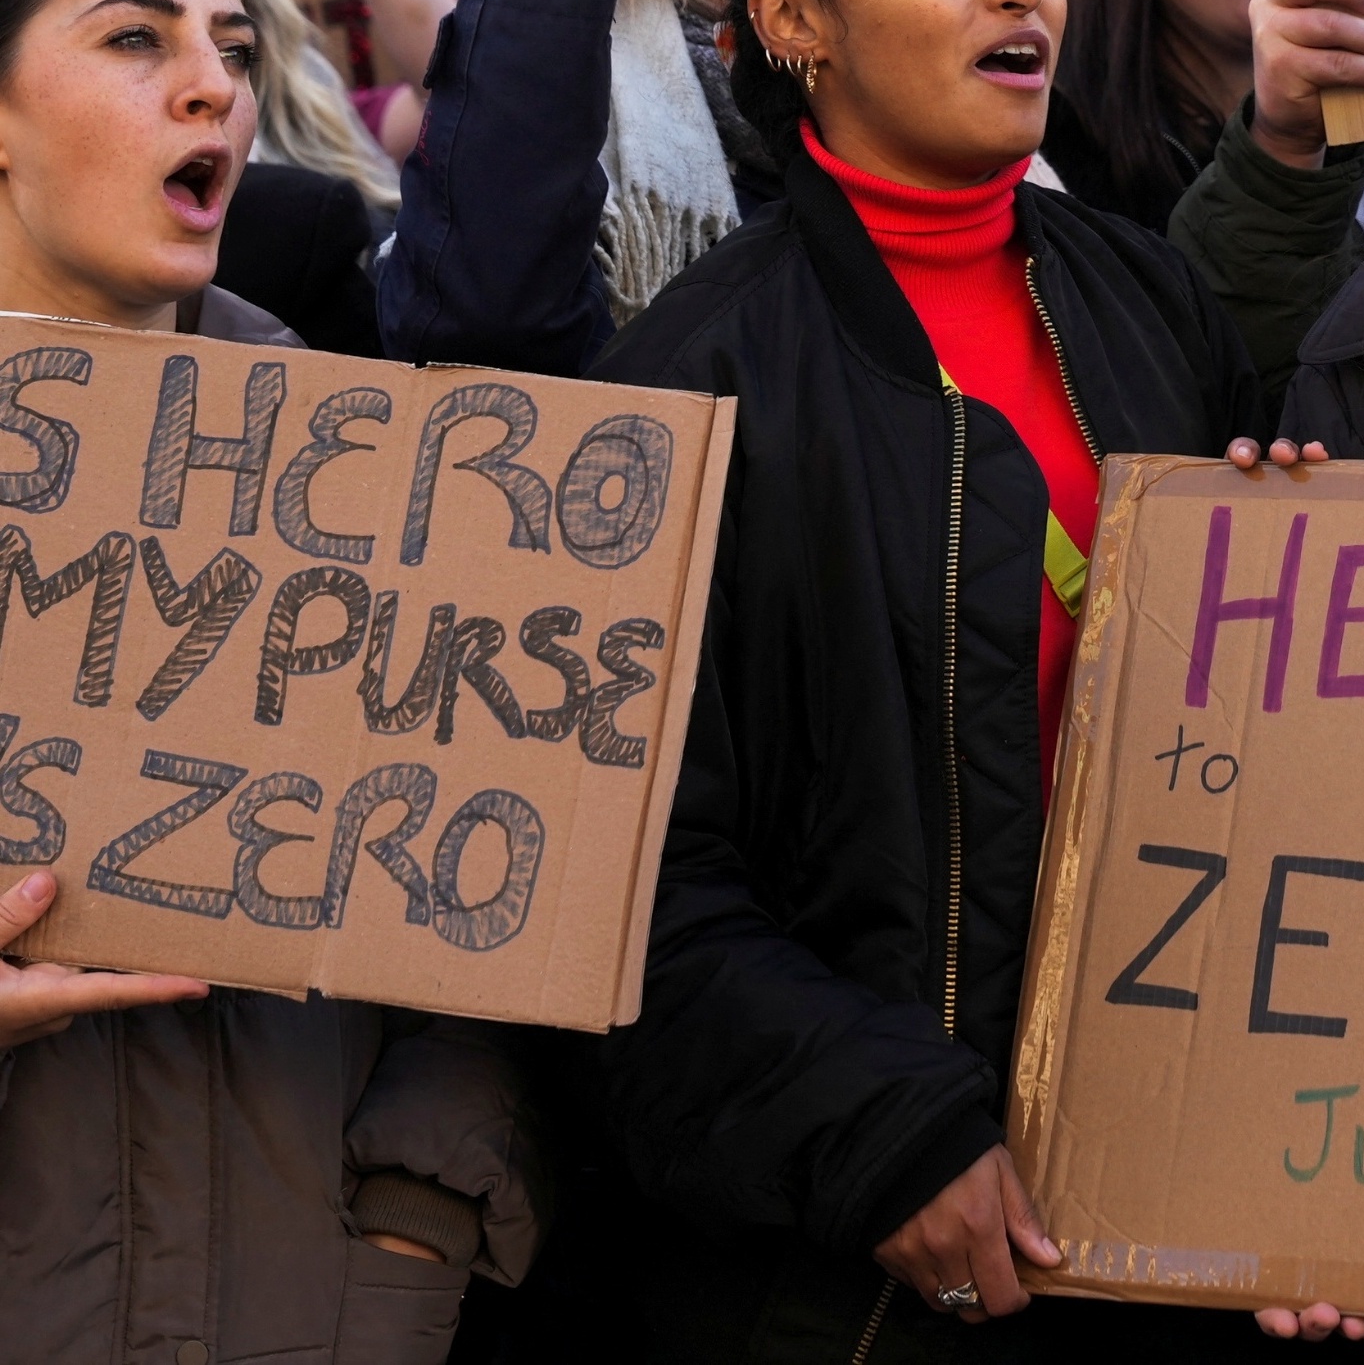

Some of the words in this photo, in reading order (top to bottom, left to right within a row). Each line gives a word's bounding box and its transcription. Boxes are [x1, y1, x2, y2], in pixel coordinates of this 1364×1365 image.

[140, 354, 674, 569] HERO
[0, 524, 262, 722] MY
[254, 566, 665, 769] PURSE
[87, 748, 546, 952] ZERO
[1155, 724, 1239, 794] to
